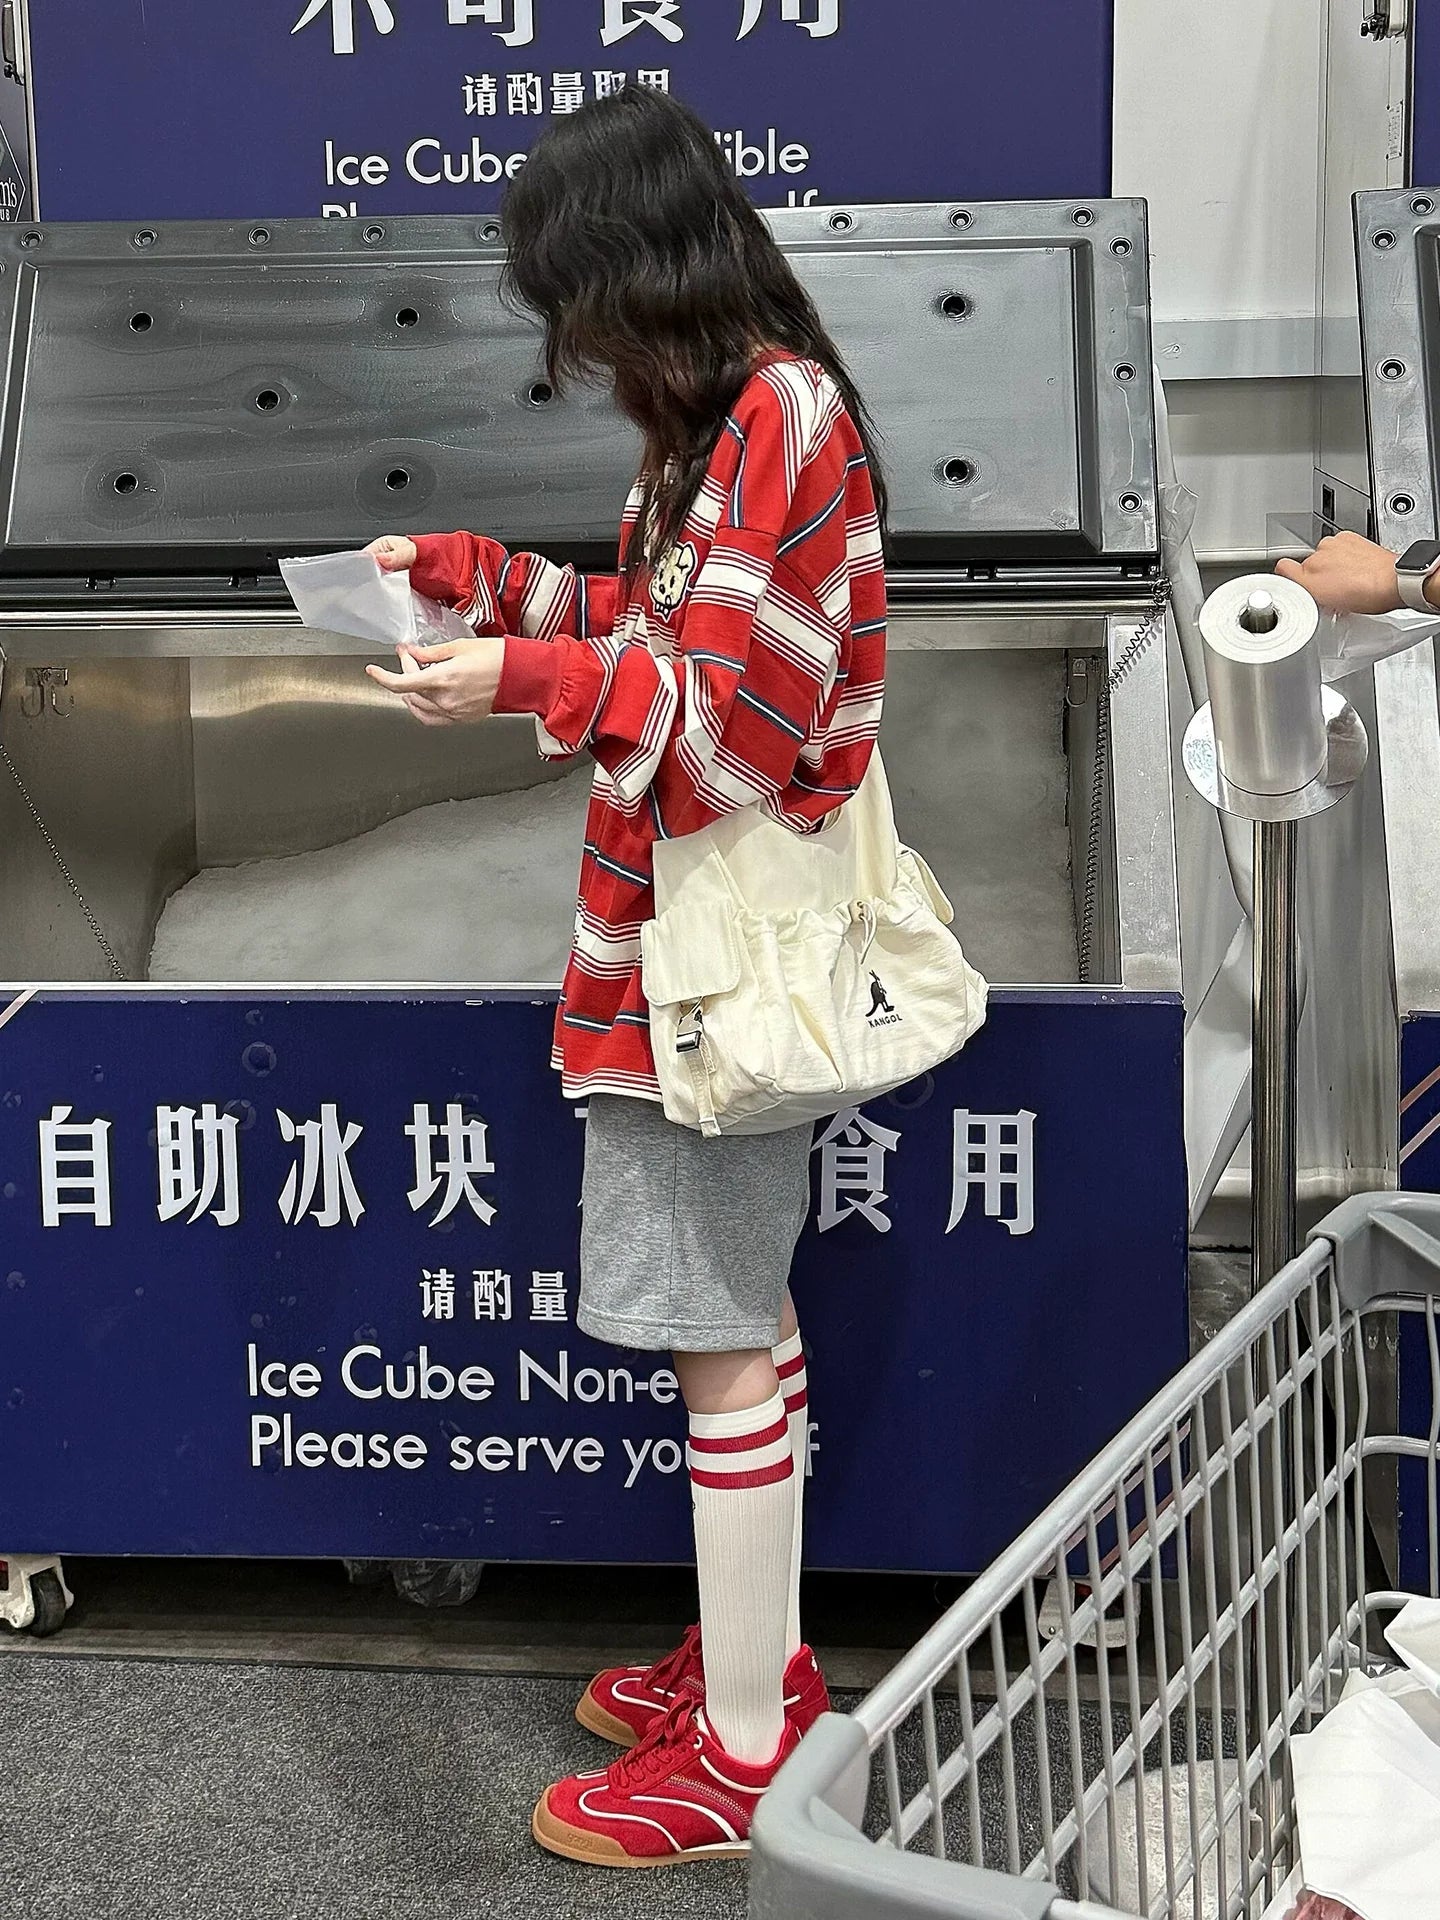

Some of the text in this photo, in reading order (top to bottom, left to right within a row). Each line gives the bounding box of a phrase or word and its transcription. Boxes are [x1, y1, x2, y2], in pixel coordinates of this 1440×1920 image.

[325, 137, 528, 186] Ice Cube
[868, 1013, 903, 1029] KANGOL
[247, 1343, 322, 1398] Ice
[341, 1344, 495, 1401] Cube
[251, 1413, 428, 1470] Please
[449, 1435, 605, 1474] serve
